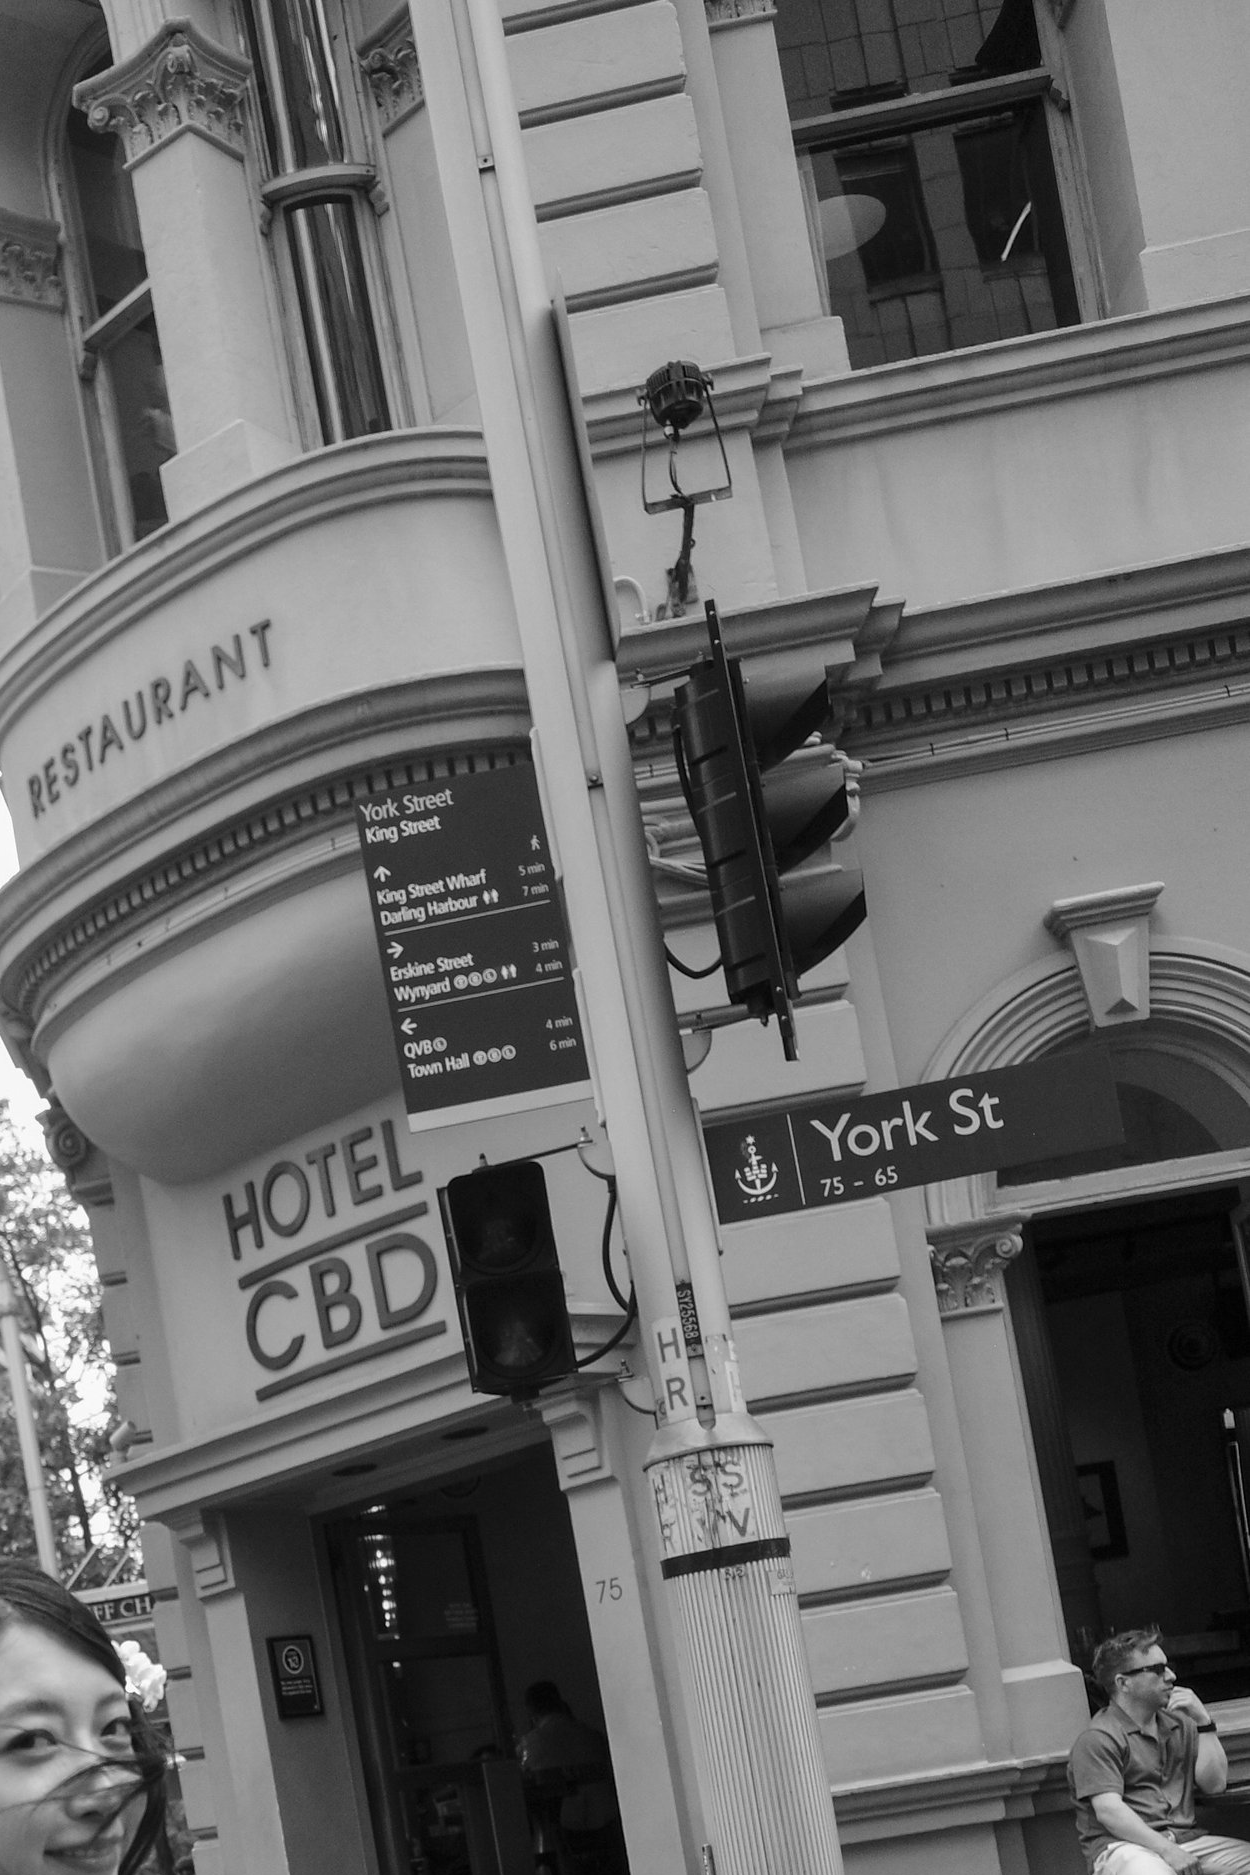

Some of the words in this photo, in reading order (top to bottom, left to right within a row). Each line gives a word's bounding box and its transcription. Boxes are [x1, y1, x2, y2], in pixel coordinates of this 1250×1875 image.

[28, 618, 272, 821] RESTAURANT
[358, 797, 401, 822] York
[402, 788, 454, 814] Street
[364, 825, 399, 844] King
[399, 815, 442, 837] Street
[376, 888, 408, 905] King
[407, 879, 446, 899] Street
[445, 868, 487, 891] Wharf
[518, 865, 526, 876] 5
[527, 862, 546, 875] min
[380, 905, 427, 926] Darling
[427, 895, 479, 917] Harbour
[521, 885, 529, 897] 7
[530, 882, 549, 895] min
[389, 961, 436, 982] Erskine
[436, 953, 475, 973] Street
[532, 941, 540, 953] 3
[541, 939, 559, 952] min
[393, 976, 452, 1003] Wynyard
[535, 962, 543, 973] 4
[545, 959, 563, 971] min
[403, 1039, 433, 1059] QVB
[545, 1018, 553, 1030] 4
[555, 1016, 573, 1028] min
[406, 1061, 444, 1079] Town
[445, 1052, 471, 1072] Hall
[549, 1039, 557, 1051] 6
[558, 1036, 577, 1050] min
[809, 1100, 940, 1162] York
[948, 1088, 1005, 1136] St
[222, 1119, 424, 1261] HOTEL
[819, 1175, 845, 1198] 75
[874, 1165, 899, 1187] 65
[246, 1232, 438, 1372] CBD
[677, 1288, 699, 1340] SY25568
[657, 1326, 681, 1363] H
[665, 1376, 688, 1411] R
[595, 1576, 623, 1604] 75
